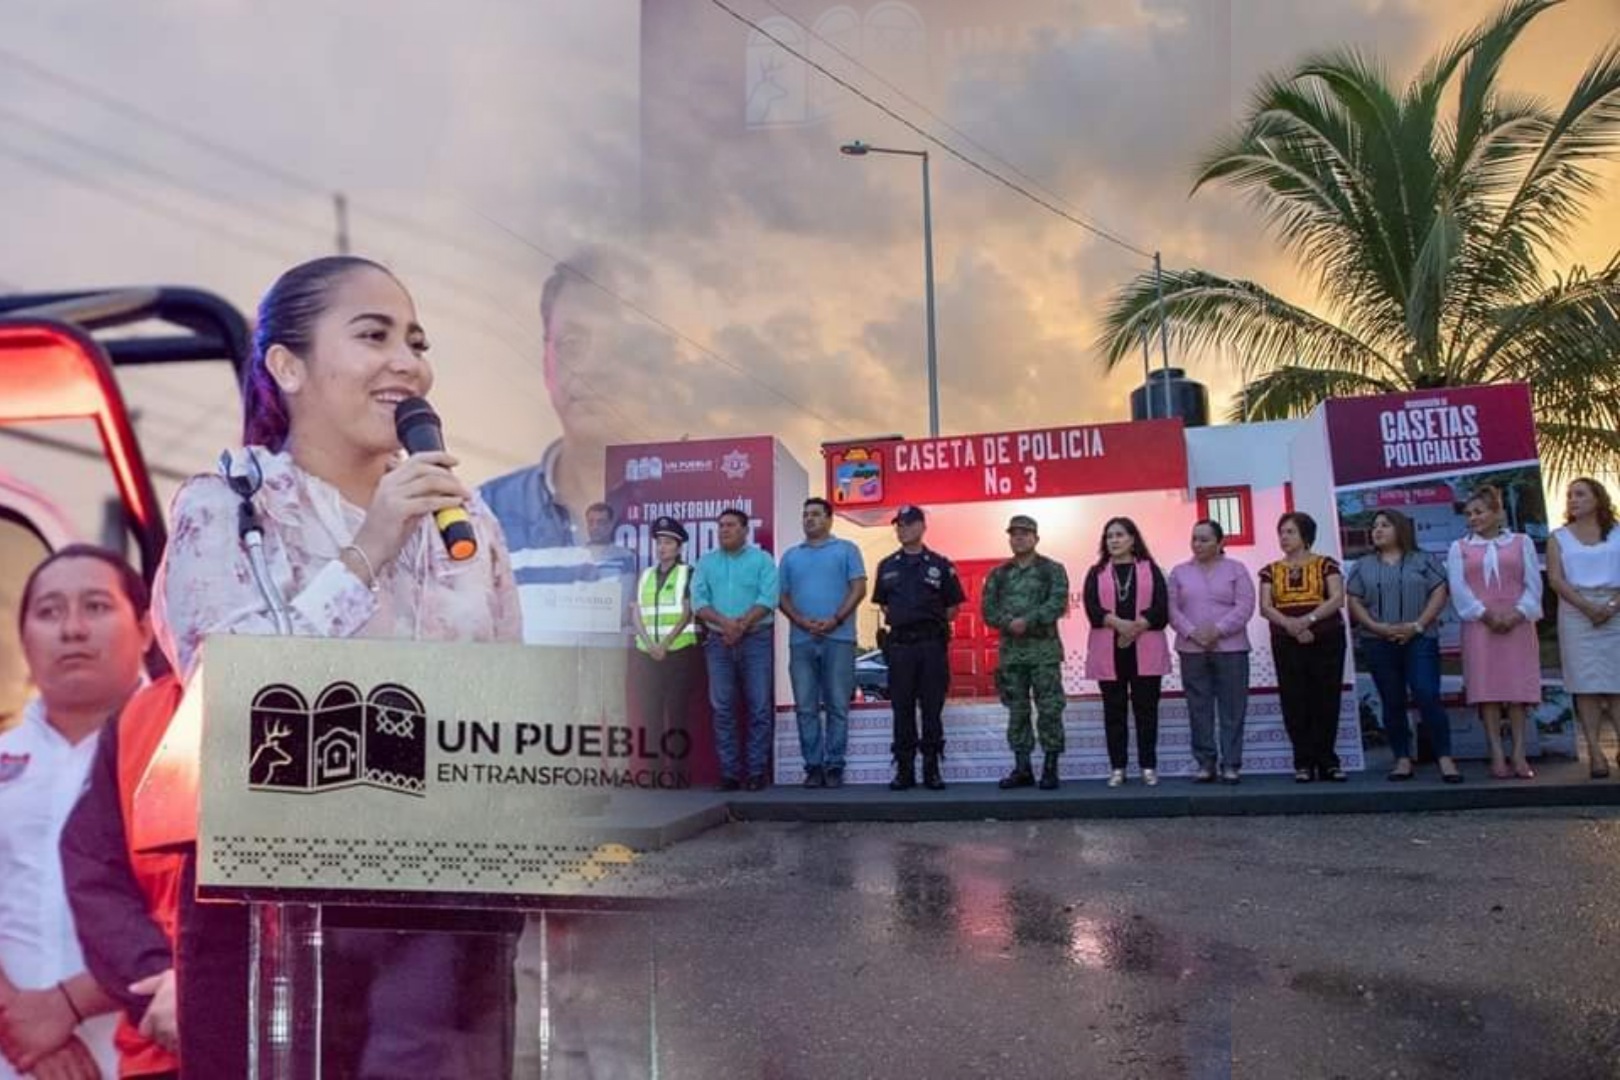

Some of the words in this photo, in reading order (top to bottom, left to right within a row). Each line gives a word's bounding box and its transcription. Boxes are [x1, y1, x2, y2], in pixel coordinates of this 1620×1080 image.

[1379, 404, 1479, 443] CASETAS
[894, 438, 977, 472] CASETA
[982, 435, 1011, 465] DE
[1018, 428, 1106, 462] POLICIA
[1382, 437, 1483, 468] POLICIALES
[984, 471, 1011, 495] No
[1024, 466, 1038, 493] 3
[627, 505, 639, 520] LA
[437, 720, 500, 754] UN
[516, 722, 692, 760] PUEBLO
[437, 763, 468, 783] EN
